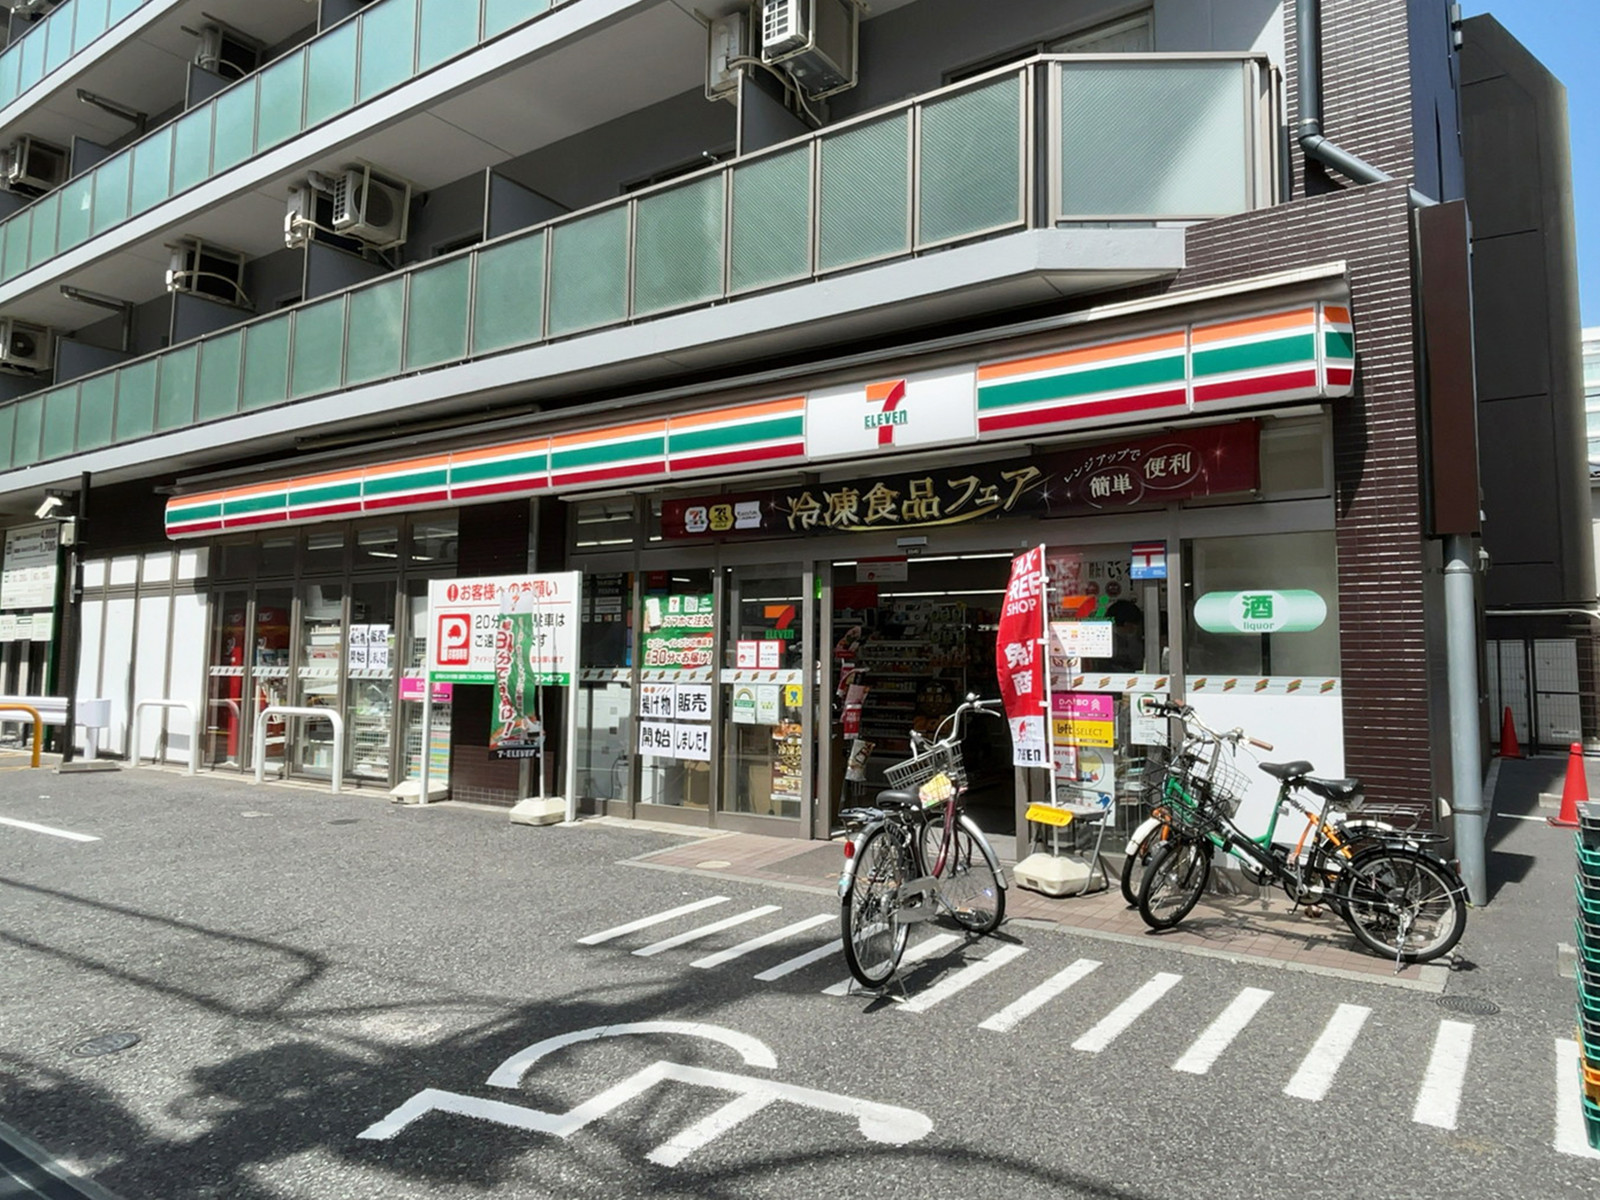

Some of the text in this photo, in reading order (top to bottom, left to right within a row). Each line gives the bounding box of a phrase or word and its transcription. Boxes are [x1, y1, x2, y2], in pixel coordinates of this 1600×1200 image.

[865, 379, 905, 445] 7
[1064, 449, 1141, 483] レンジアップで
[1143, 451, 1192, 479] 便利
[787, 466, 1042, 531] 冷凍食品フェア
[1089, 473, 1133, 498] 簡単
[1013, 550, 1037, 578] AX-
[1008, 571, 1041, 601] REE
[1006, 599, 1037, 616] SHOP
[1242, 595, 1273, 619] 酒
[1243, 621, 1275, 631] liquor
[678, 692, 707, 712] 販売
[642, 727, 708, 753] 開始 しました!
